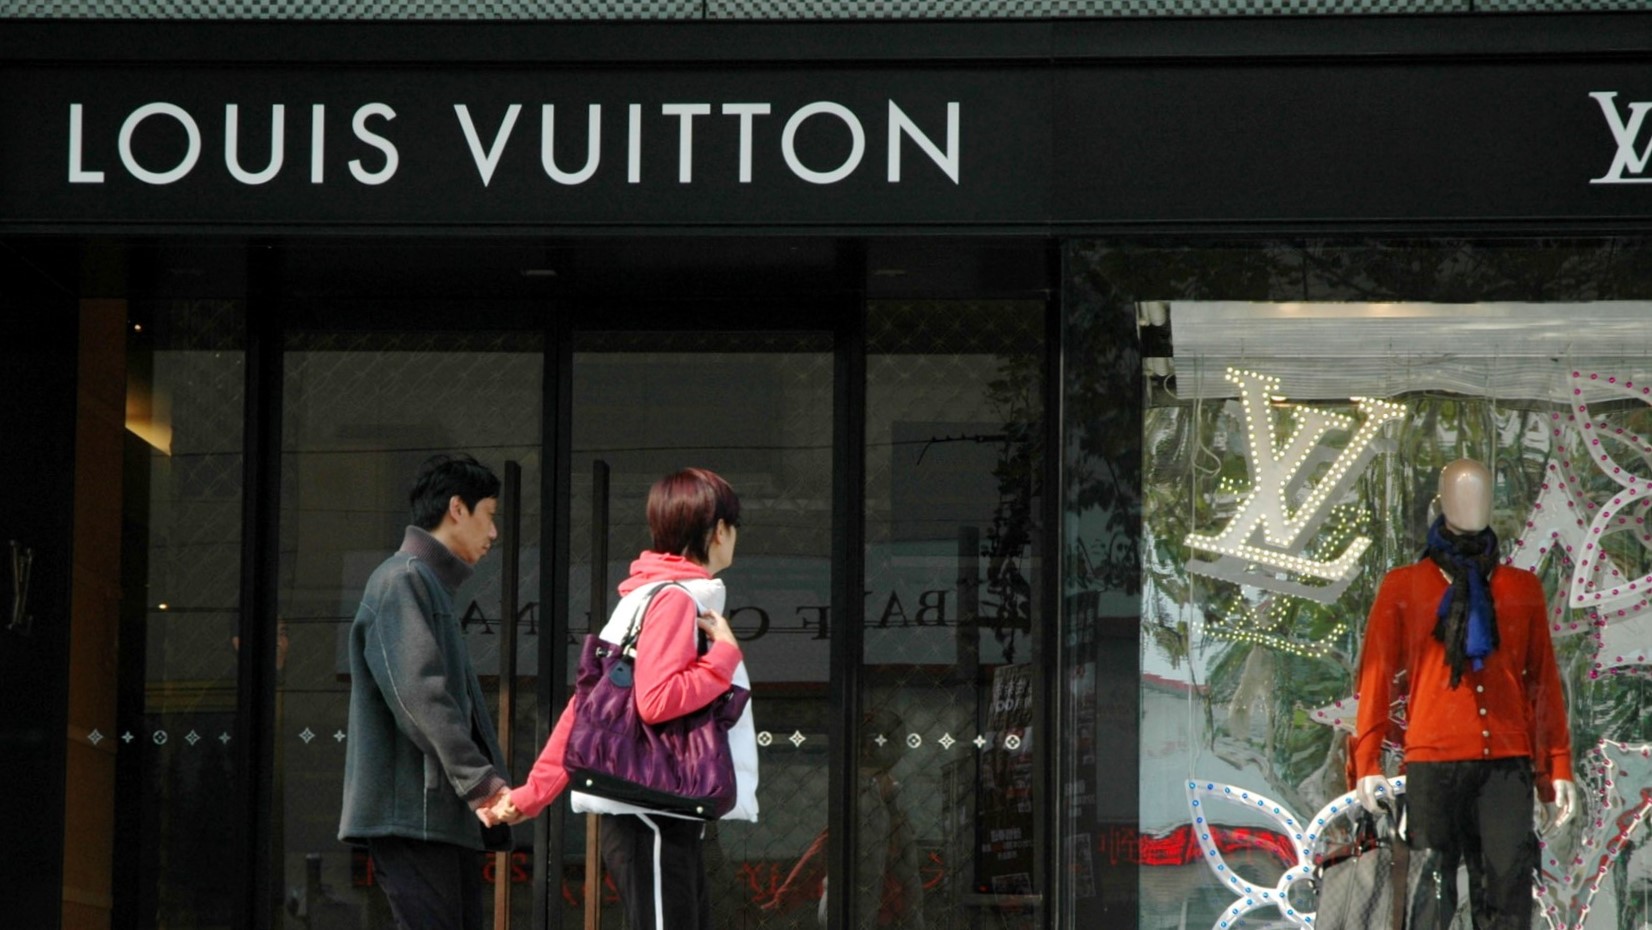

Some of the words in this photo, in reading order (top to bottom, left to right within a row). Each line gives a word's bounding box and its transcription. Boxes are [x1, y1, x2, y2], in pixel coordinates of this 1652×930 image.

[69, 102, 399, 185] LOUIS
[453, 99, 961, 187] VUITTON
[1184, 366, 1407, 581] LV
